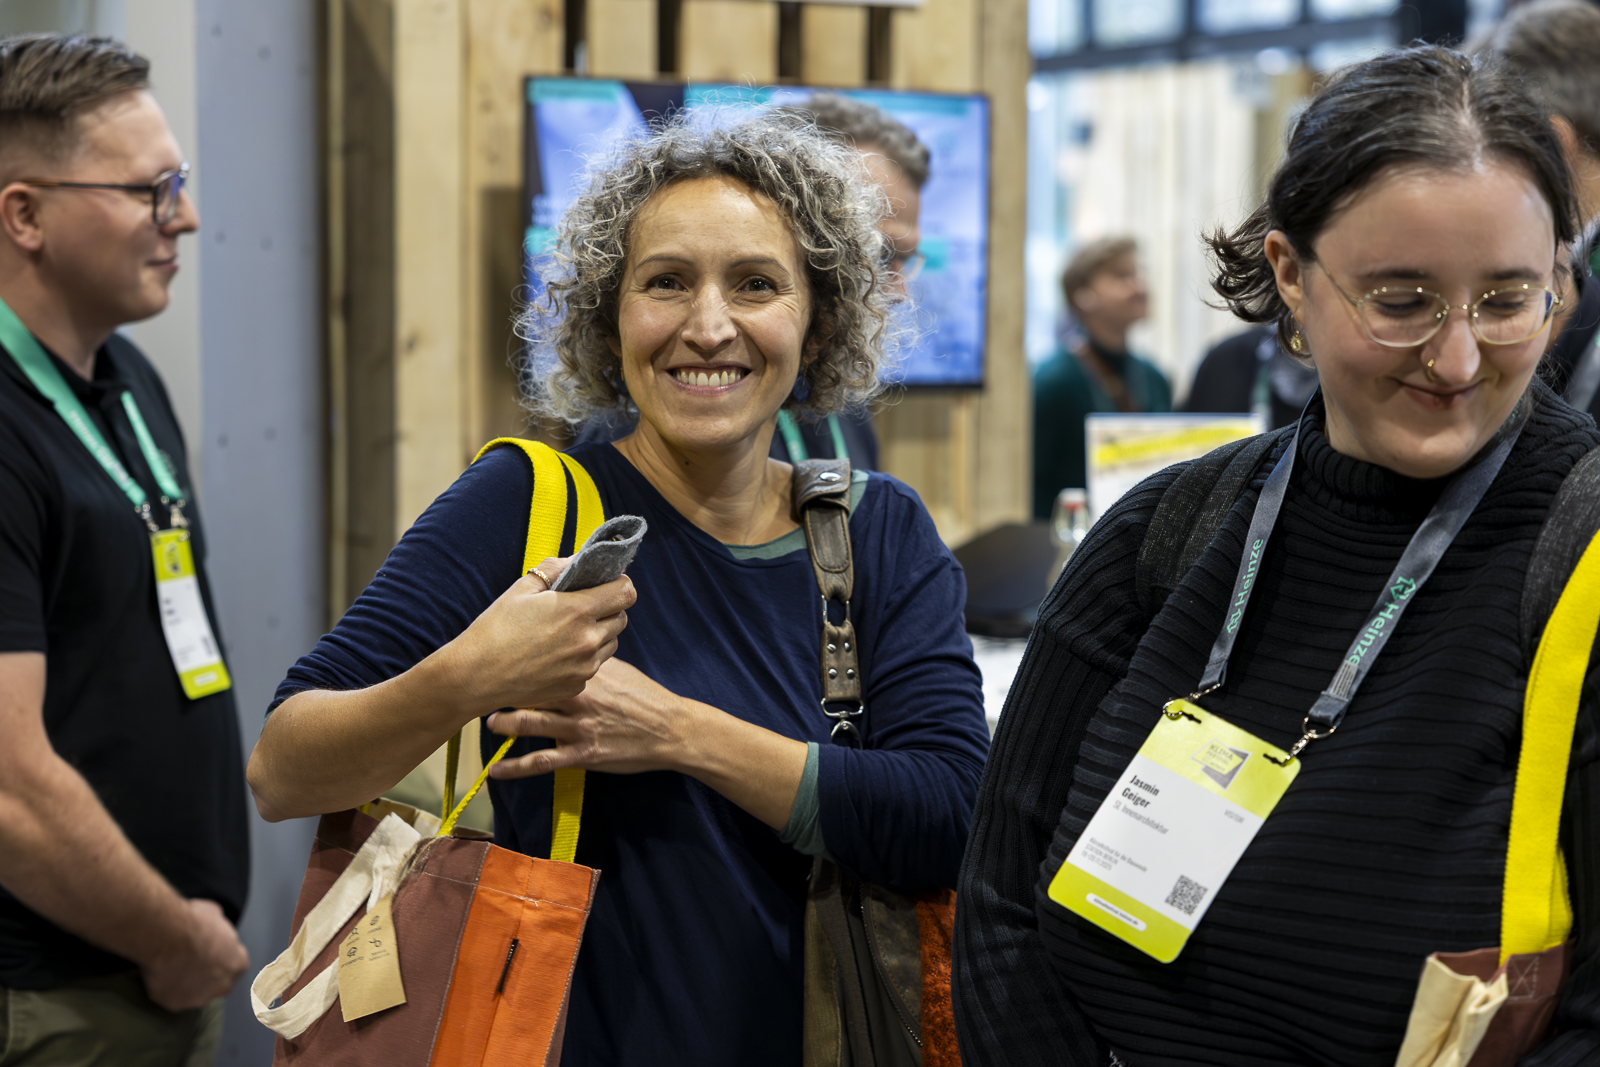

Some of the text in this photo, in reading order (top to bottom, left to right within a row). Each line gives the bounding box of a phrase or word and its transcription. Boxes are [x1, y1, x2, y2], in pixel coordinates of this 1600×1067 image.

[1235, 538, 1264, 607] Heinze
[1349, 602, 1400, 666] Heinze
[1121, 787, 1150, 808] Geiger
[1129, 774, 1160, 796] Jasmin
